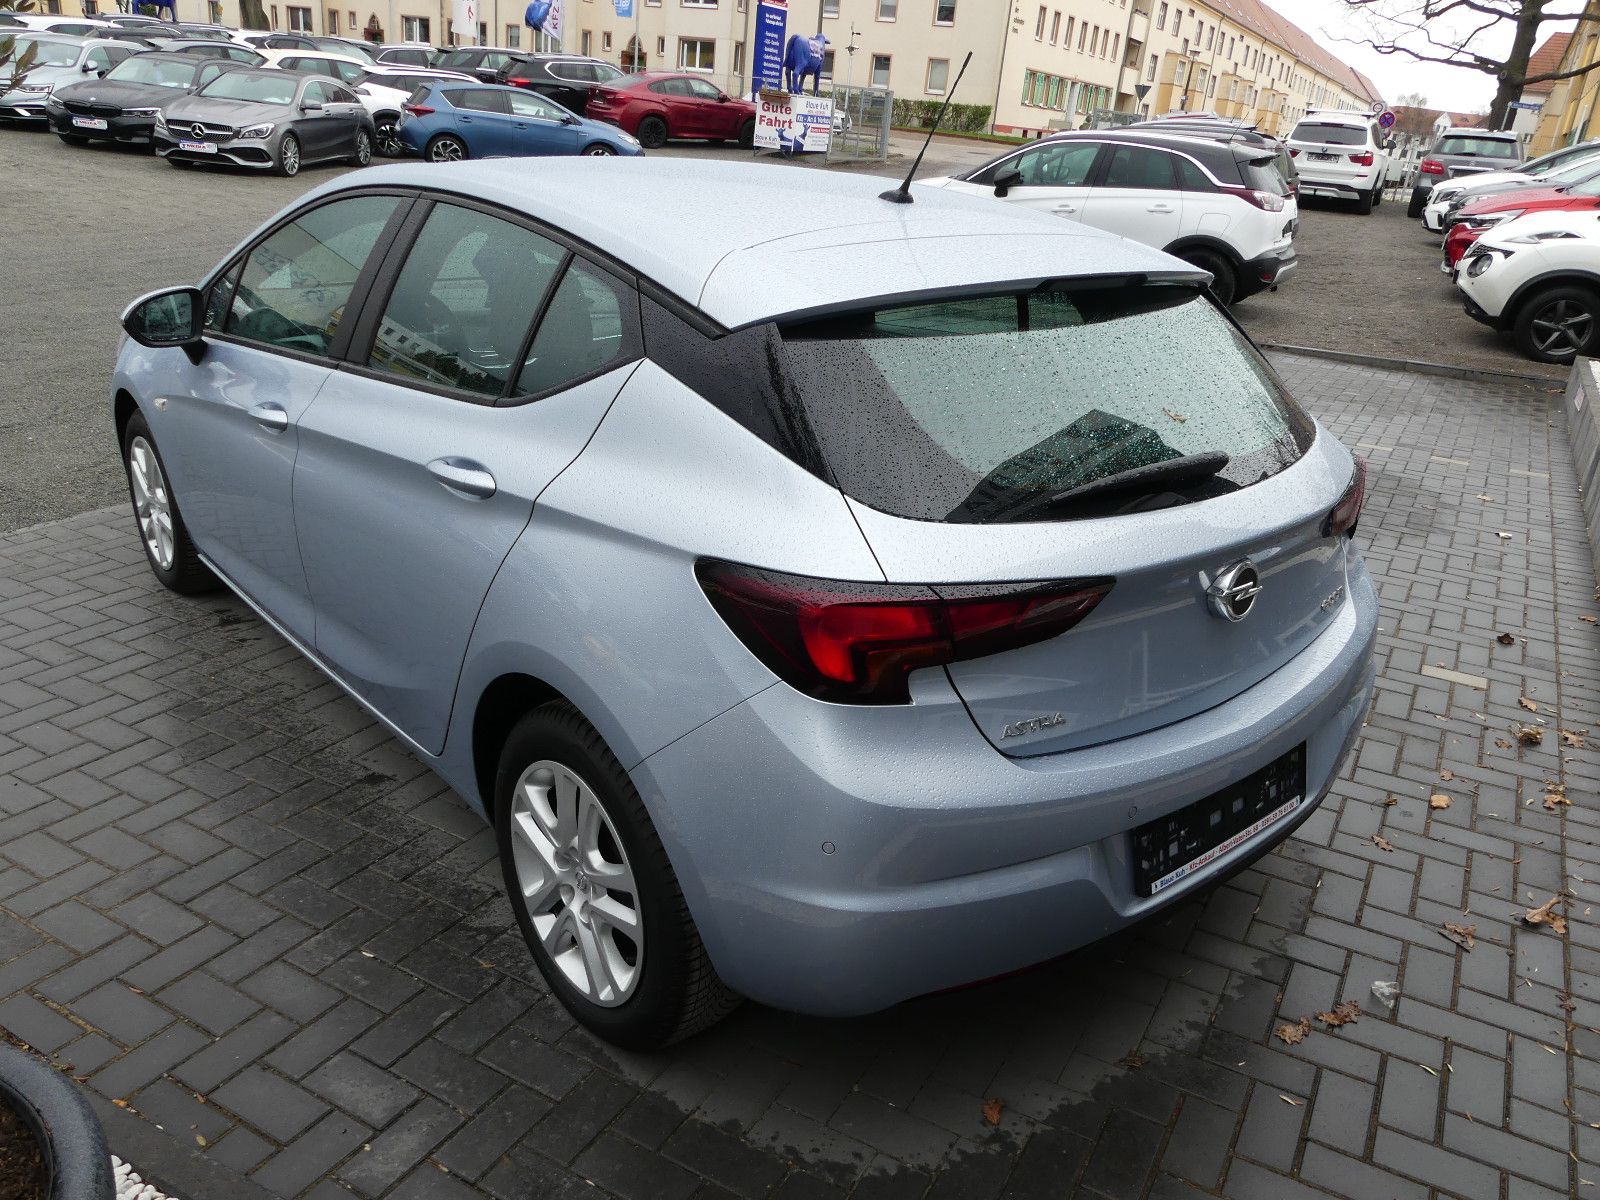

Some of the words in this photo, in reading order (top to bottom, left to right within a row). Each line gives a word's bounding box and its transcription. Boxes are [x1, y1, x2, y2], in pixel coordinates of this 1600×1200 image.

[552, 6, 560, 30] KFZ
[761, 101, 792, 115] Gute
[758, 115, 793, 129] Fahrt
[1000, 712, 1066, 740] ASTRA
